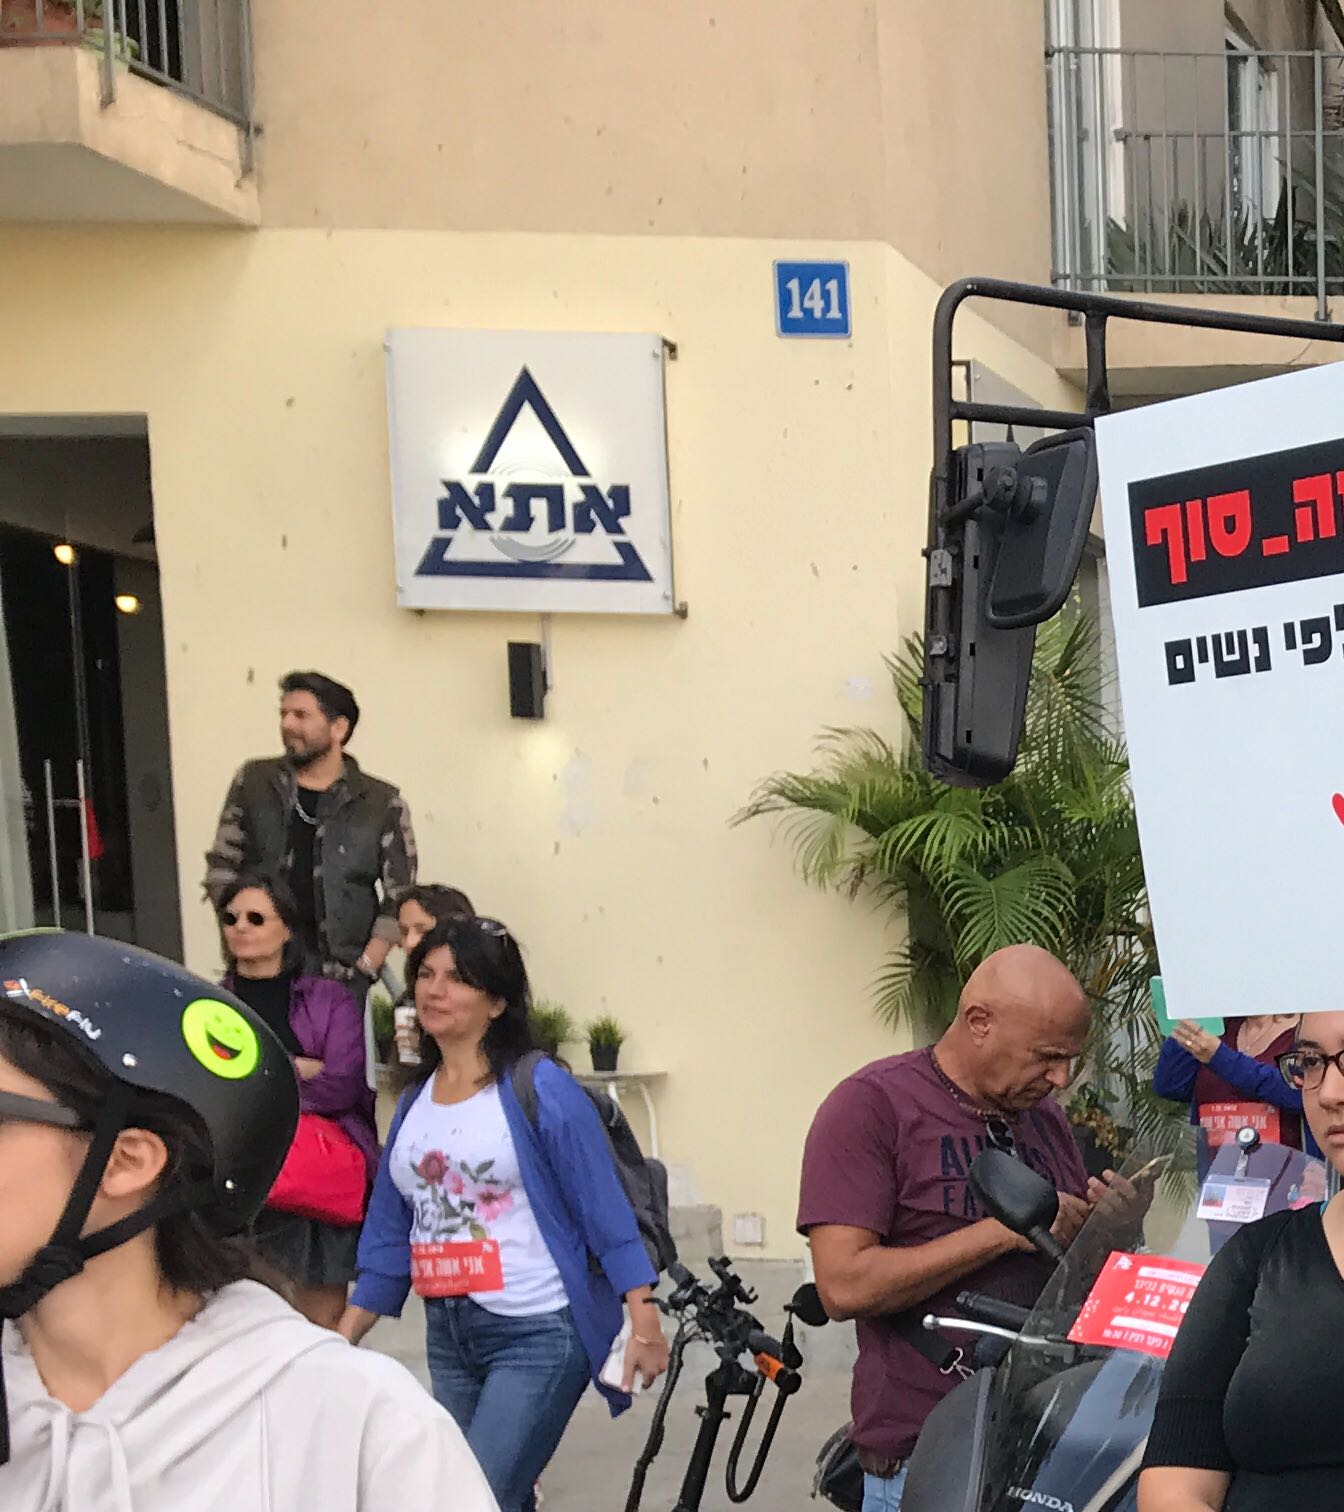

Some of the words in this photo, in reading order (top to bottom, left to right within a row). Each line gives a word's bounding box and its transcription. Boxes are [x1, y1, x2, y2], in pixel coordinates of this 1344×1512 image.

[786, 277, 843, 320] 141
[437, 477, 632, 536] אתא
[1163, 625, 1273, 686] נשים
[1124, 1290, 1190, 1314] 4.12.20
